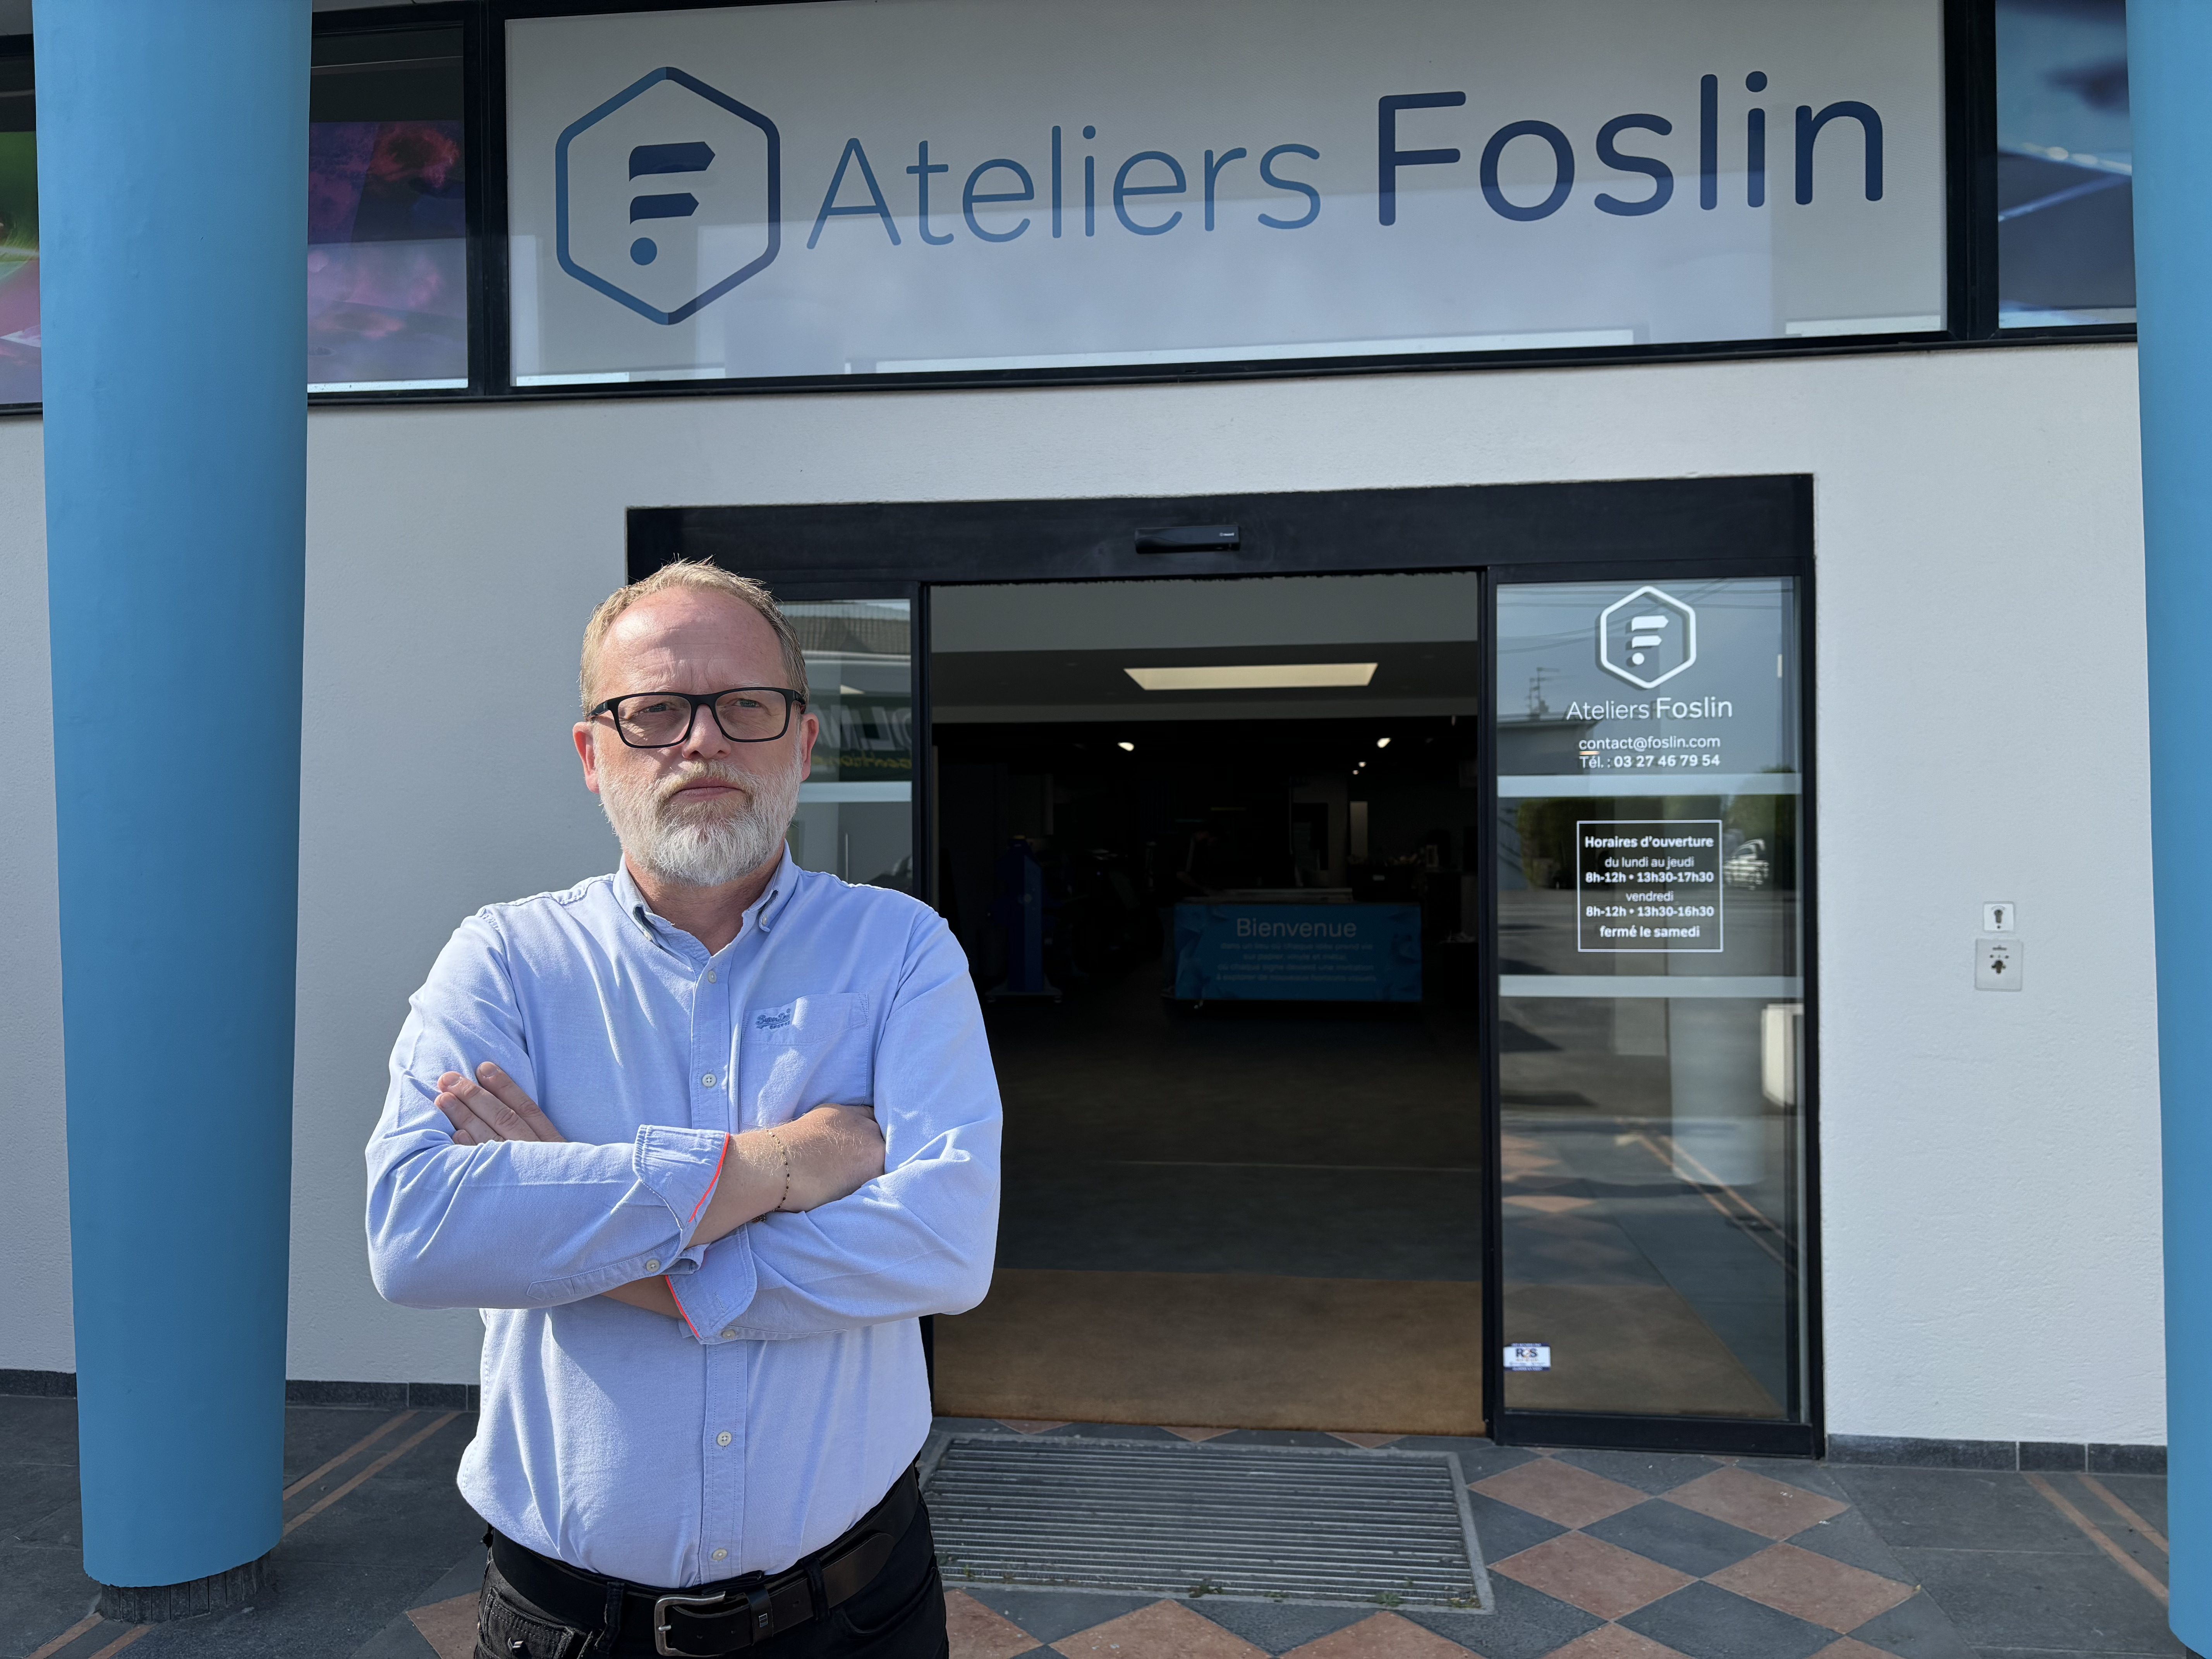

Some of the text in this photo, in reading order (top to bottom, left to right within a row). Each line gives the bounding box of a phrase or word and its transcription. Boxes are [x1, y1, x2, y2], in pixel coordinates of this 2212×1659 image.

[807, 71, 1883, 249] Ateliers Foslin
[1566, 696, 1732, 720] Ateliers Foslin
[1579, 735, 1721, 752] contact@foslin.com
[1579, 756, 1604, 769] Tél.
[1614, 756, 1632, 768] 03
[1636, 755, 1654, 767] 27
[1658, 755, 1676, 767] 46
[1680, 754, 1698, 766] 79
[1702, 754, 1720, 766] 54
[1585, 836, 1638, 848] Horaires
[1604, 856, 1694, 870] du lundi au jeudi
[1585, 872, 1626, 883] 8h-12h
[1637, 871, 1714, 883] 13h30-17h30
[1625, 891, 1674, 902] vendredi
[1586, 906, 1627, 917] 8h-12h
[1637, 906, 1714, 917] 13h30-16h30
[1237, 918, 1357, 938] Bienvenue
[1600, 925, 1700, 938] fermé le samedi
